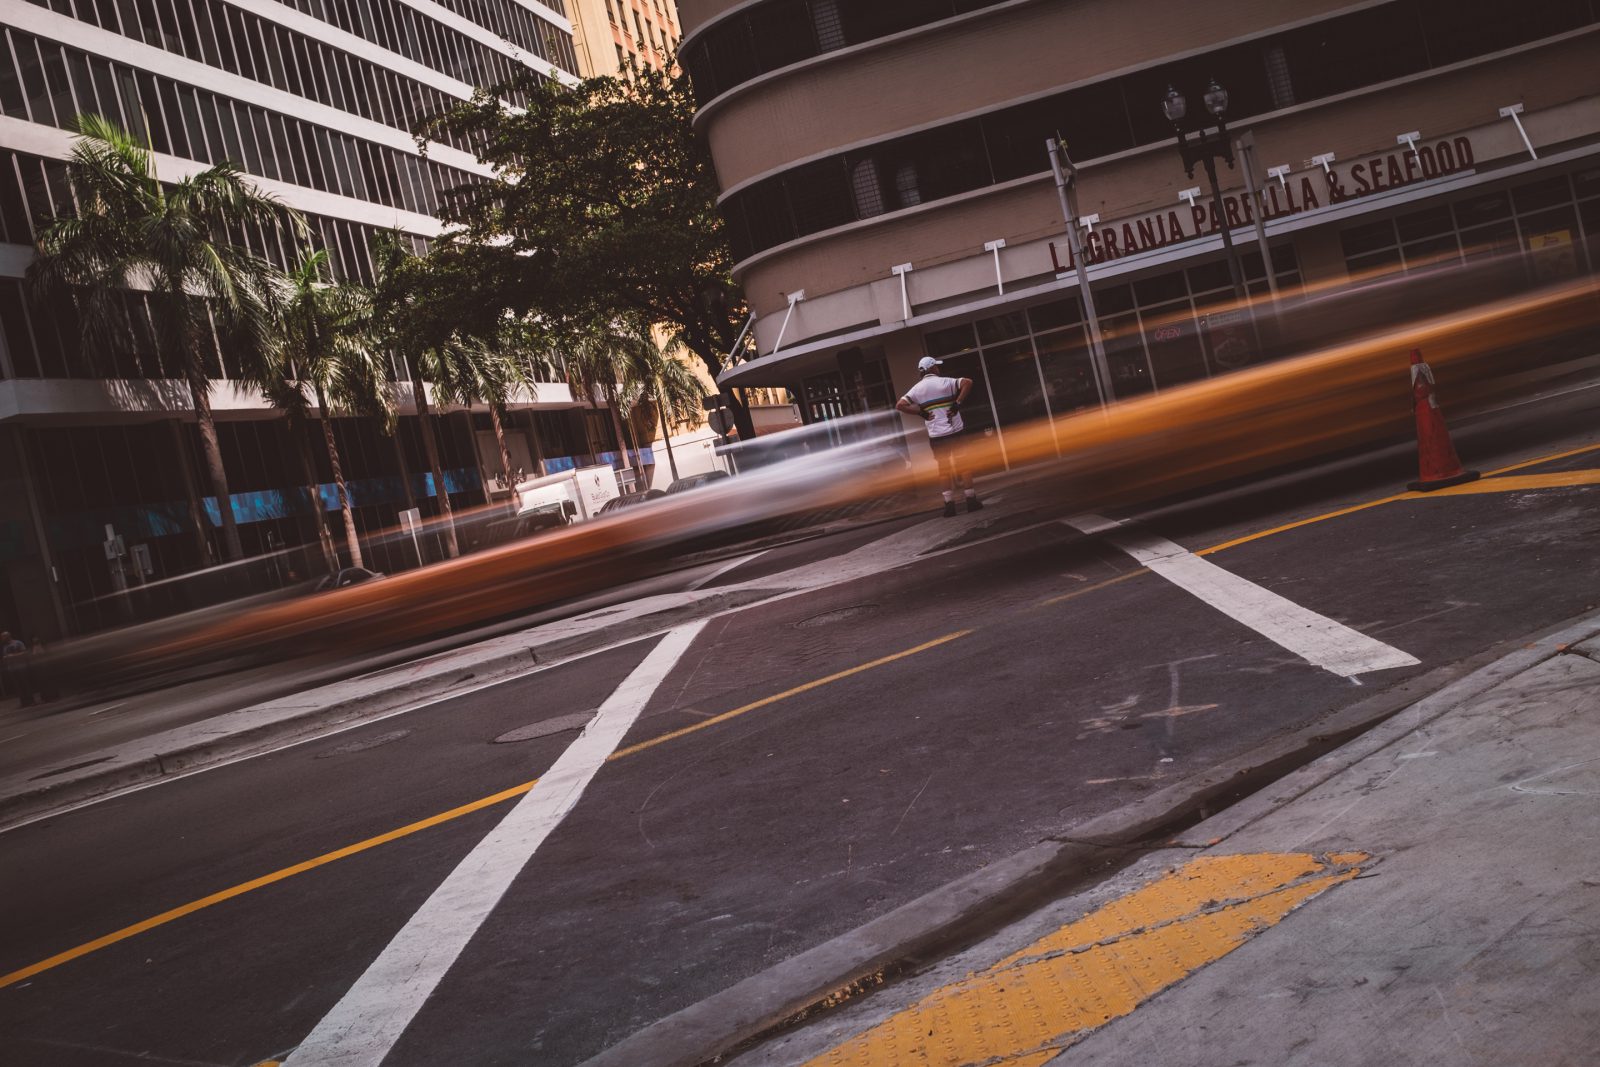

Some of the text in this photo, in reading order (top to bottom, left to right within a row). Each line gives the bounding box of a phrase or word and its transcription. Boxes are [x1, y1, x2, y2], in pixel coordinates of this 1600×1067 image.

[1087, 211, 1184, 264] GRANJA
[1326, 170, 1347, 204] &
[1351, 136, 1474, 196] SEAFOOD
